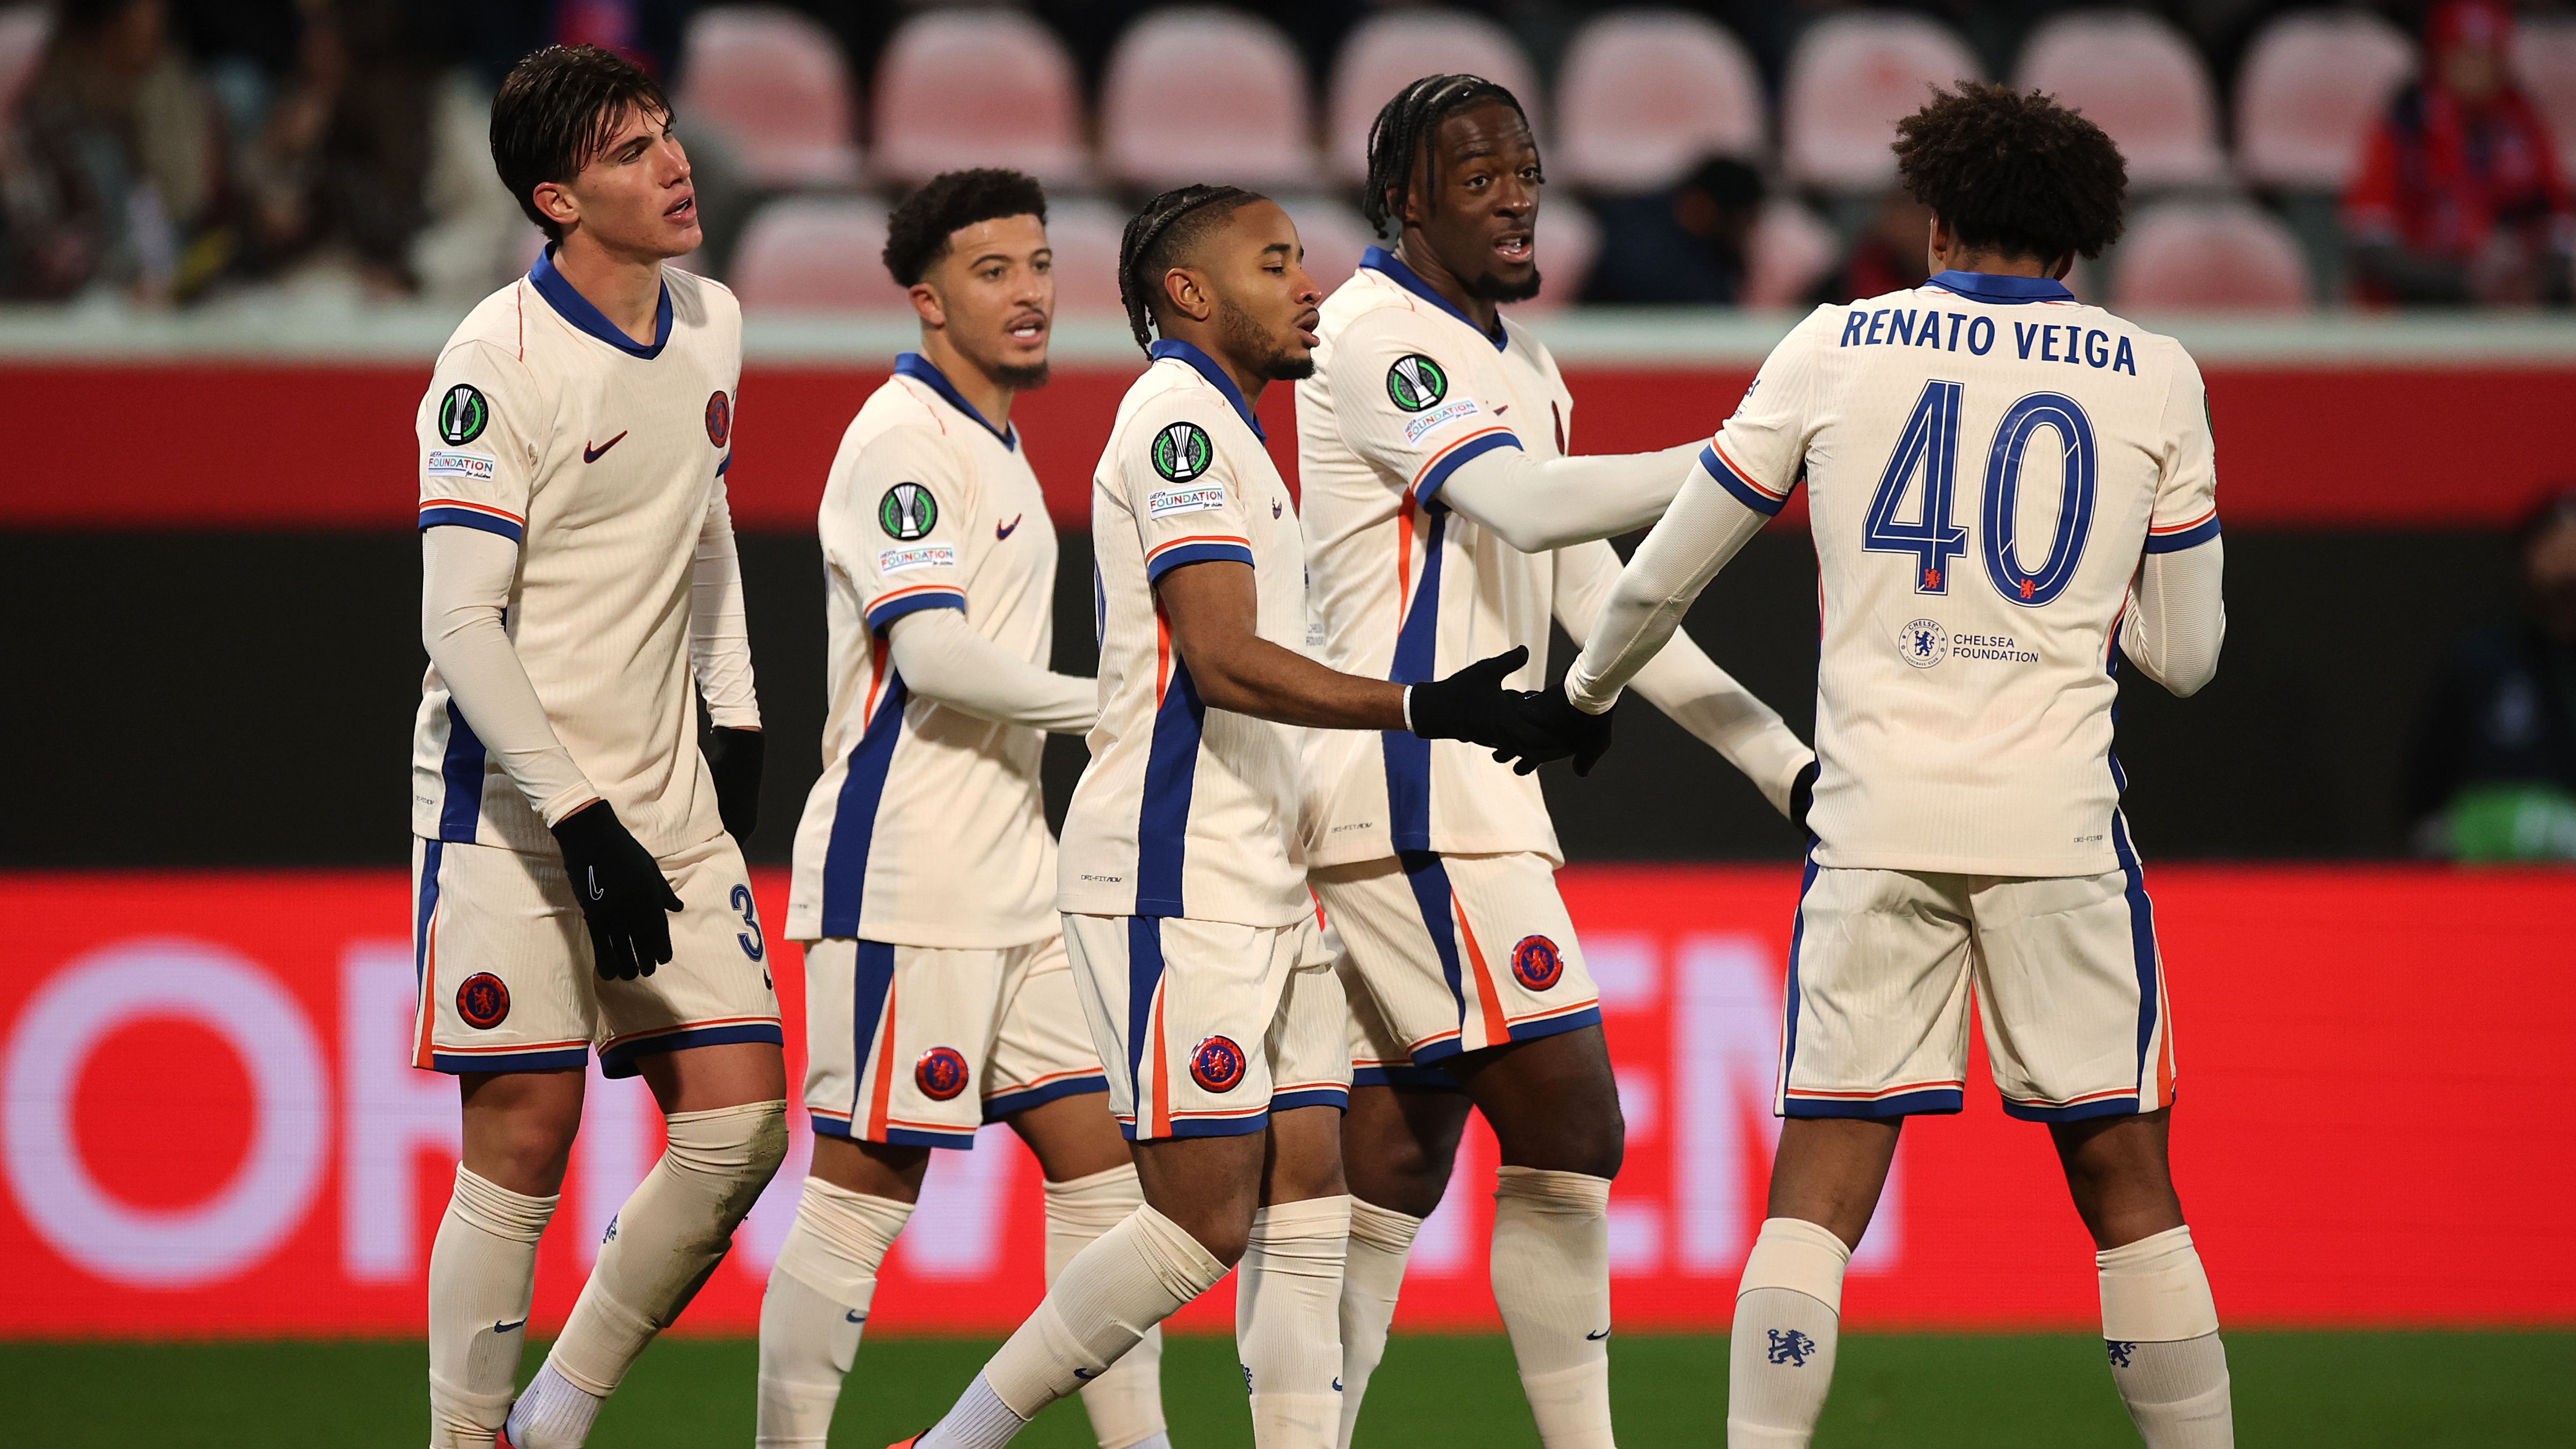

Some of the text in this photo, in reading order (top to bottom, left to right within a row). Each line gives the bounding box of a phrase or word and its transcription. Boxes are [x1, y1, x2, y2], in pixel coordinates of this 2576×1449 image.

[1841, 309, 2137, 376] RENATO VEIGA
[1407, 402, 1475, 441] FOUNDATION
[428, 458, 493, 472] FOUNDATION
[1150, 491, 1166, 500] UEFA
[1150, 490, 1223, 510] FOUNDATION
[1862, 378, 2099, 609] 40
[881, 549, 953, 569] FOUNDATION
[1908, 620, 1940, 633] CHELSEA
[1953, 634, 2015, 648] CHELSEA
[1905, 655, 1939, 667] FOOTBALL CLUB
[1952, 647, 2039, 663] FOUNDATION
